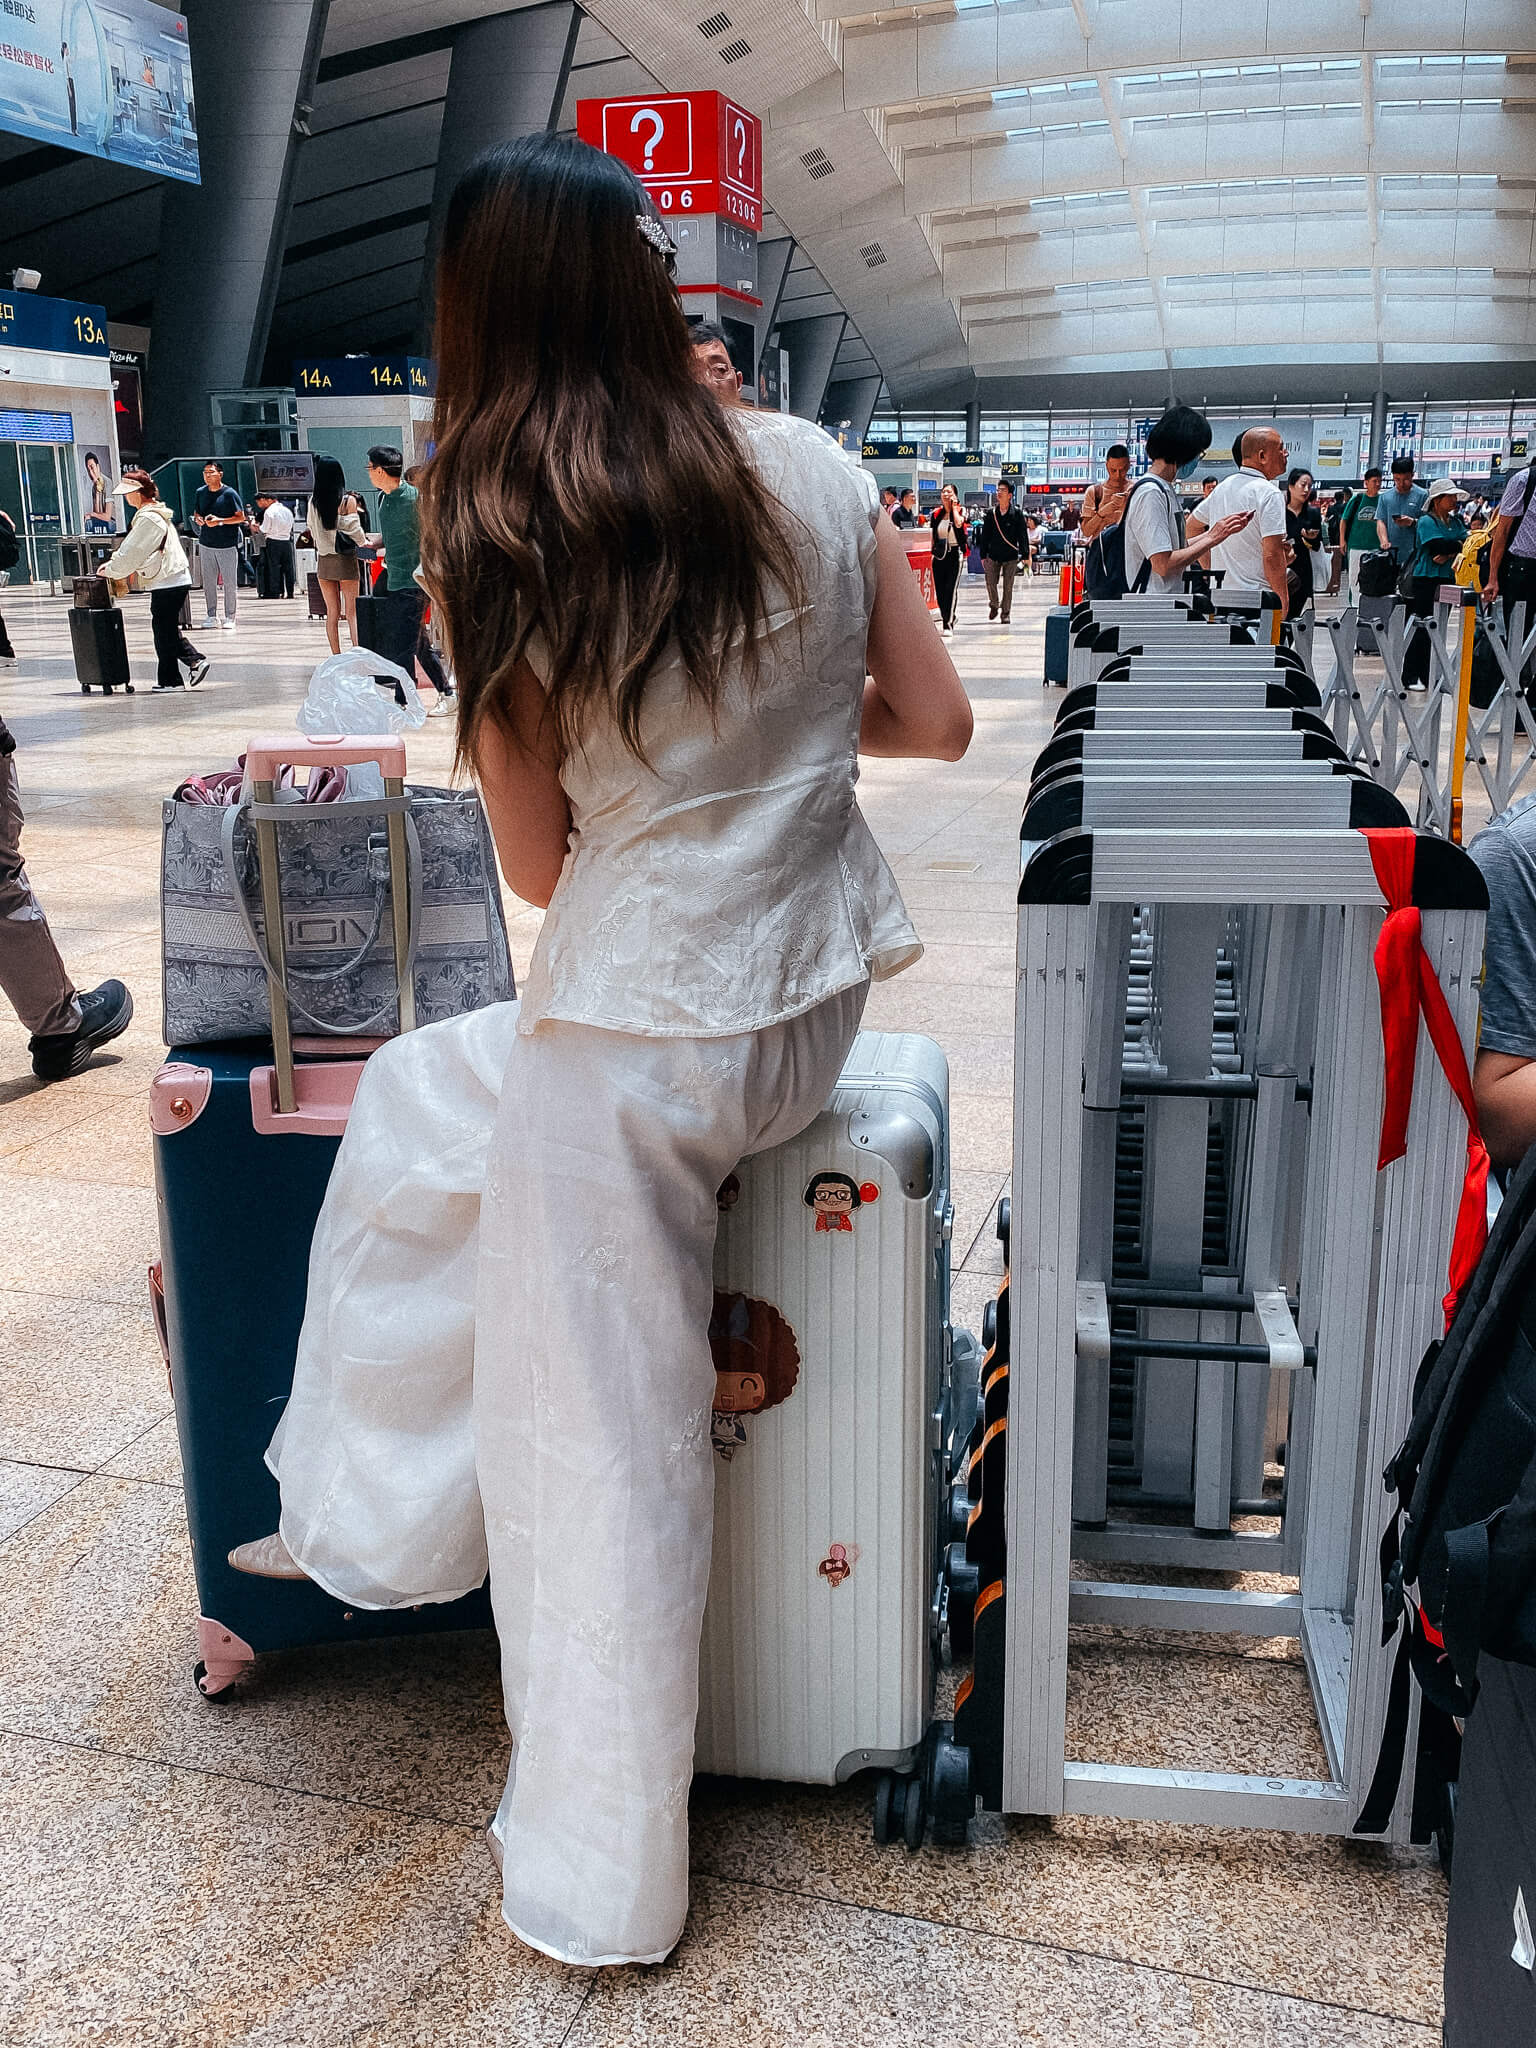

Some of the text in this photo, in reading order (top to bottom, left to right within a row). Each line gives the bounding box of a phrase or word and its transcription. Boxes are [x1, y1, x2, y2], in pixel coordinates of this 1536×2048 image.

[726, 194, 756, 223] 12306
[74, 315, 105, 344] 13A
[109, 350, 138, 364] Pizza Hut
[300, 368, 332, 388] 14A
[370, 366, 403, 387] 14A
[410, 367, 428, 387] 14A
[897, 445, 914, 455] 20A
[965, 455, 980, 464] 22A
[1008, 464, 1019, 473] 24
